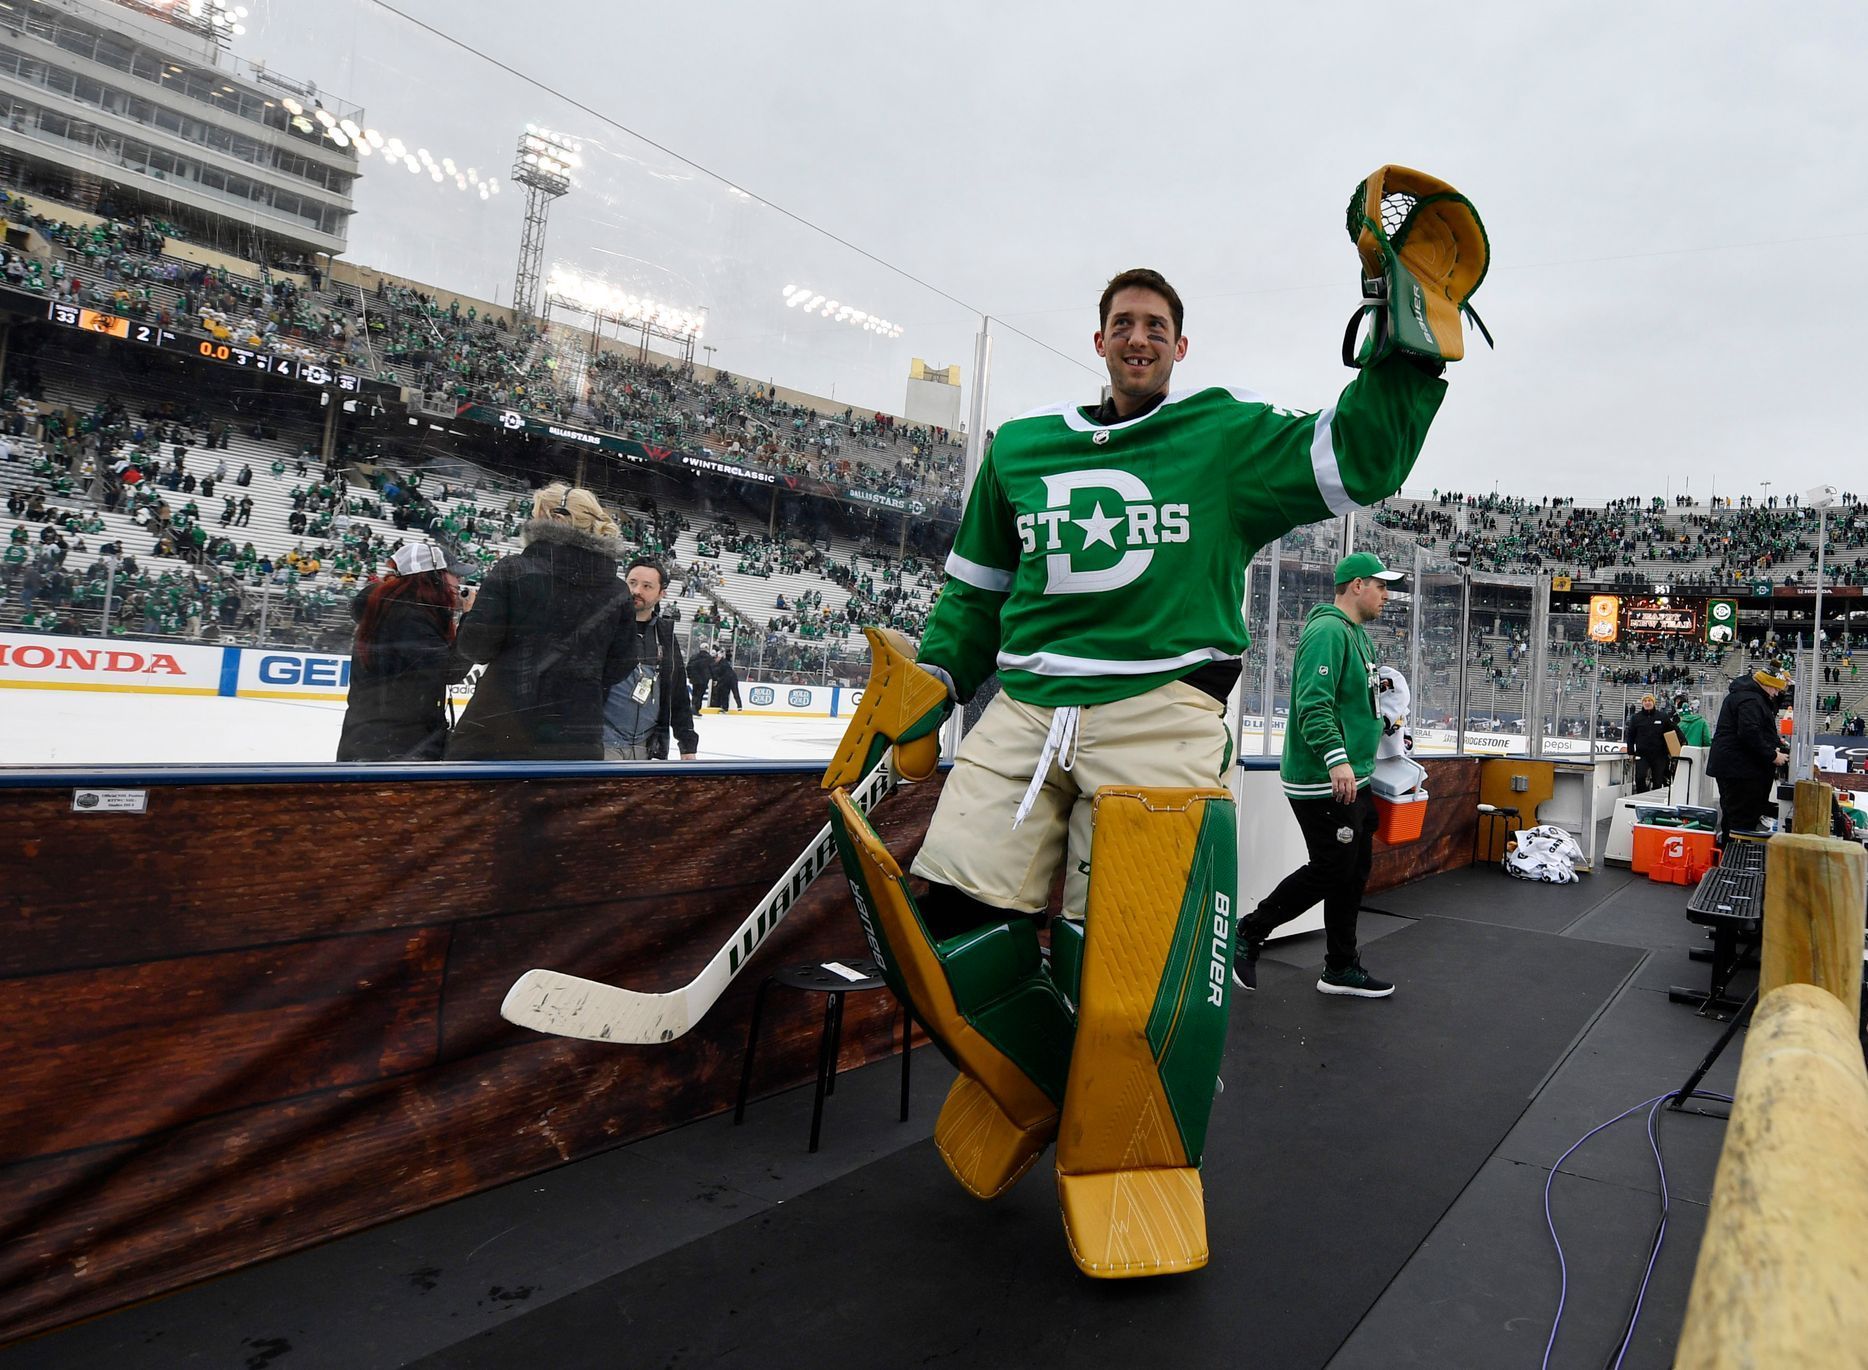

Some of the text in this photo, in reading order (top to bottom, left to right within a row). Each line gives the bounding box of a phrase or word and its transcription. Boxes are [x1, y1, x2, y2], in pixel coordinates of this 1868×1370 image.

[56, 311, 76, 324] 33
[136, 326, 150, 342] 2
[200, 341, 230, 360] 0.0
[237, 355, 247, 365] 3
[277, 361, 290, 375] 4
[339, 379, 354, 391] 35
[548, 426, 601, 445] DALLAS STARS
[682, 456, 776, 483] #WINTERCLASSIC
[849, 489, 905, 509] DALLAS STARS
[1544, 740, 1572, 750] pepsi
